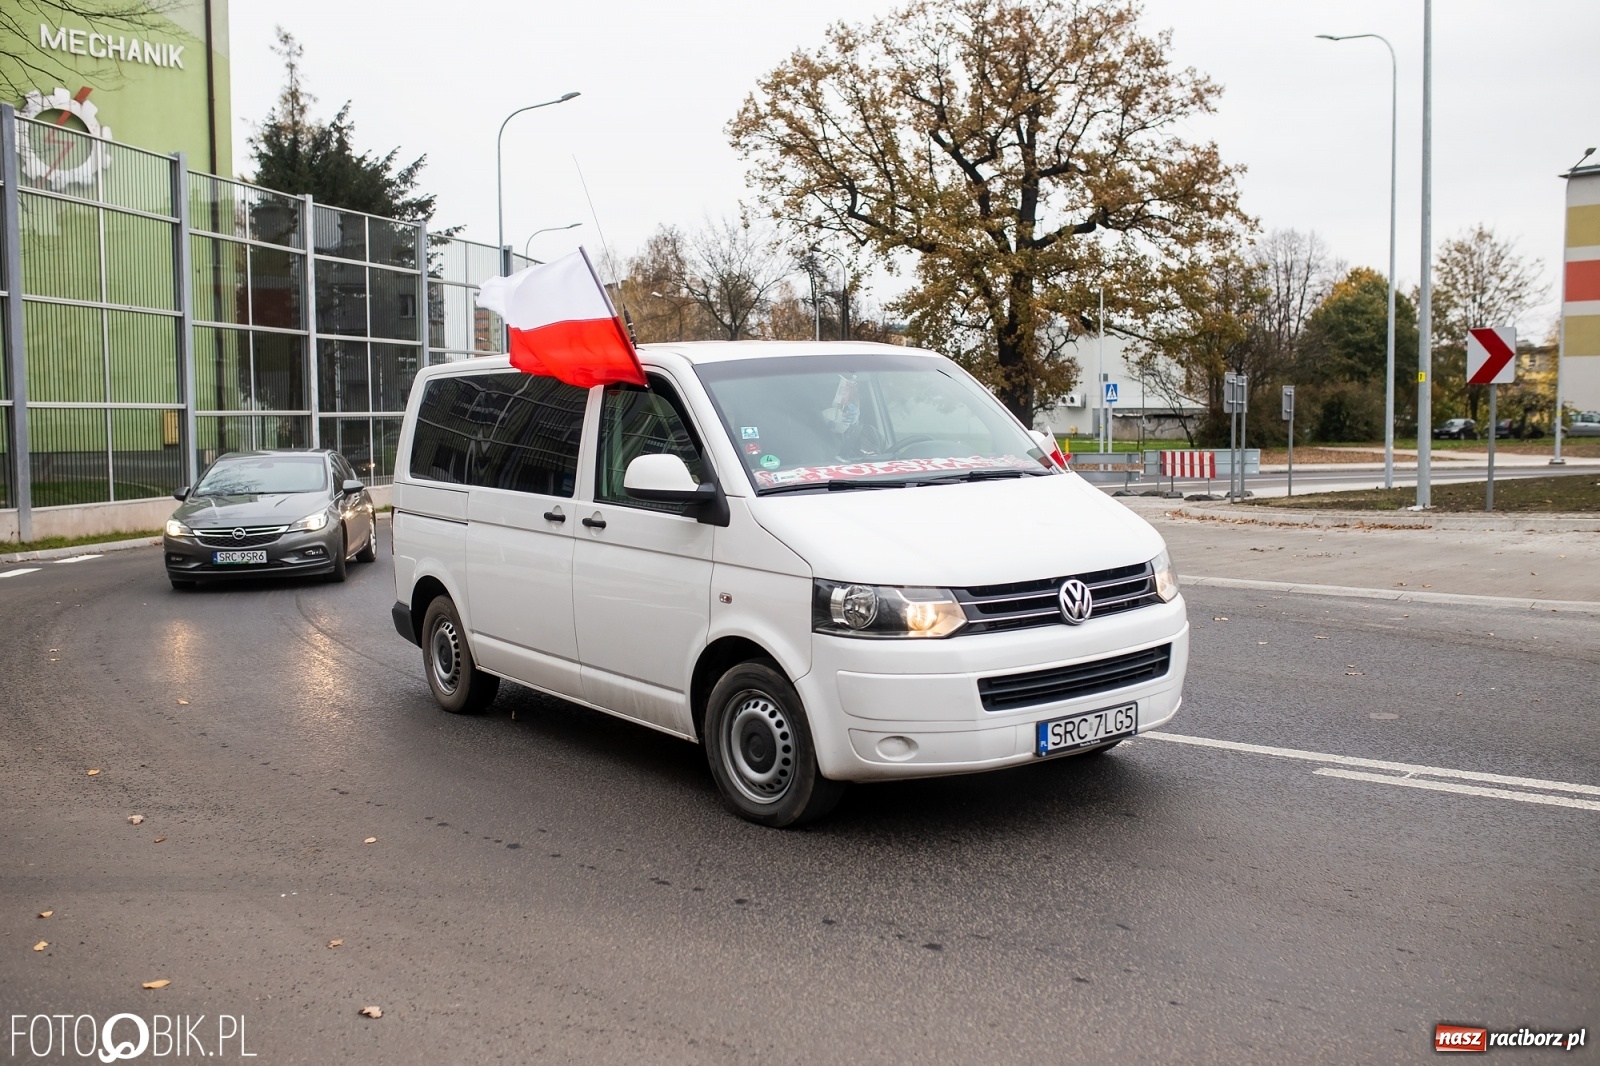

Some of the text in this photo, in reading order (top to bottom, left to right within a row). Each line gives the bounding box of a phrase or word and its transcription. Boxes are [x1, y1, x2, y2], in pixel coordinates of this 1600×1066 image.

[40, 23, 185, 70] MECHANIK
[219, 551, 265, 562] SRC 9SR6
[1051, 706, 1134, 746] SRC 7LG5
